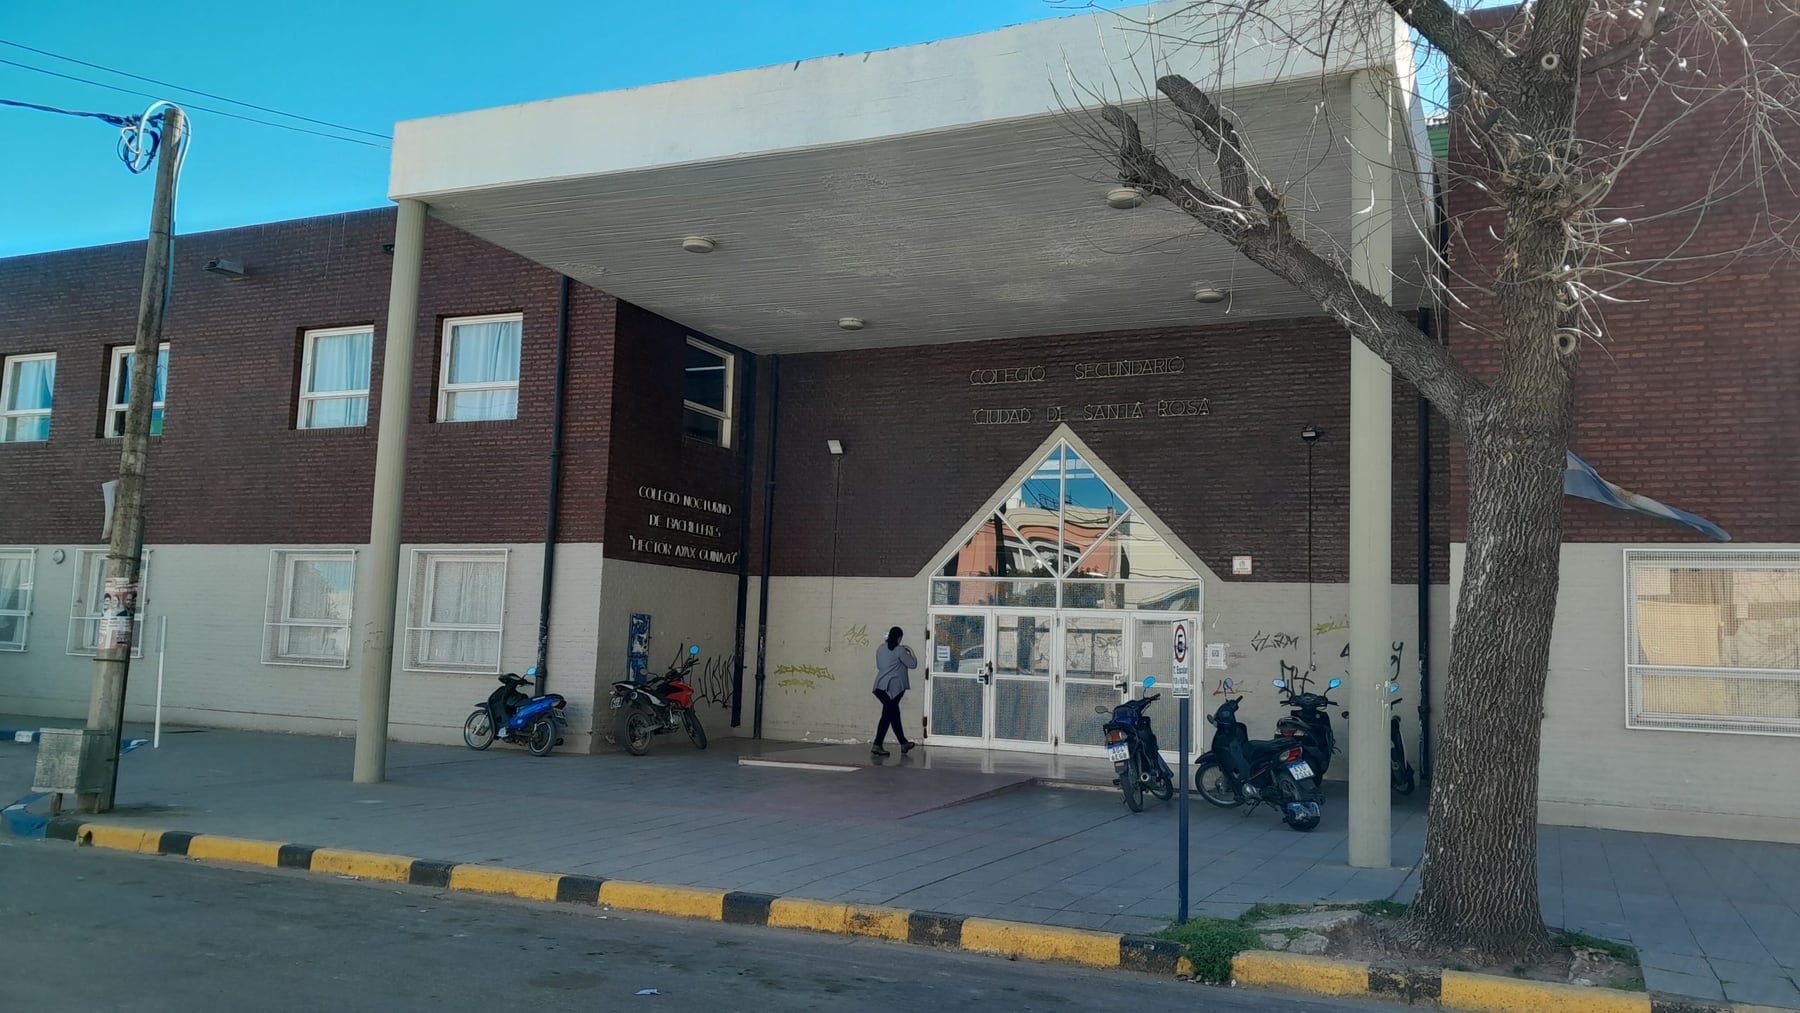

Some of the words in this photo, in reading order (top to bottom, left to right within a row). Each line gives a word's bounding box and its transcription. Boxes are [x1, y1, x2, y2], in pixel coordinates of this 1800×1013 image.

[969, 365, 1046, 385] COLEGIO
[1074, 356, 1185, 380] SECUNDARIO
[973, 408, 1032, 425] CIUDAD
[1046, 406, 1067, 422] DE
[1083, 401, 1144, 421] SANTA
[1157, 398, 1210, 417] ROSA
[638, 485, 680, 505] COLEGIO
[683, 495, 732, 516] NOCTURNO
[649, 514, 663, 527] DE
[666, 517, 721, 537] BACHILLERES
